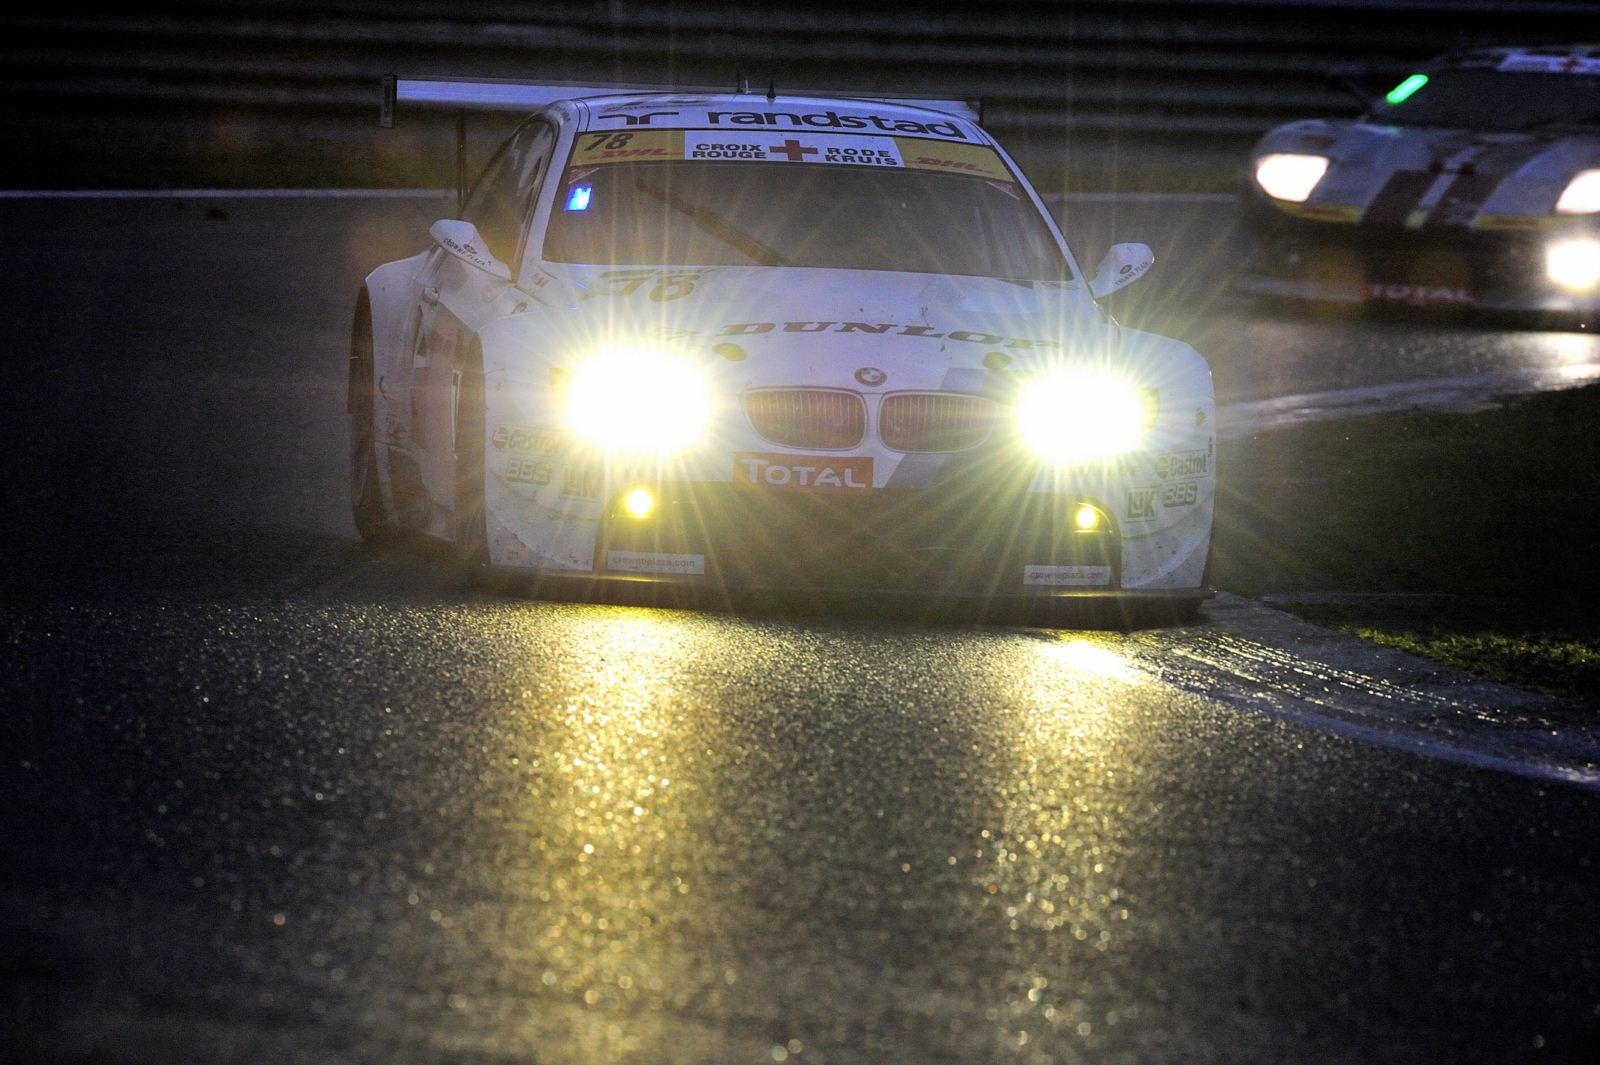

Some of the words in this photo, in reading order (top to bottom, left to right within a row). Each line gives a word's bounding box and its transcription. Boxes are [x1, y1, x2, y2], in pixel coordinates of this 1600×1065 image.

[706, 109, 967, 139] randstad
[582, 133, 634, 152] 78
[696, 143, 762, 152] CROIX
[827, 146, 891, 158] RODE
[692, 150, 767, 159] ROUGE
[824, 154, 899, 165] KRUIS
[602, 269, 702, 302] 78
[715, 321, 1064, 350] DUNLOP
[740, 458, 868, 488] TOTAL
[1169, 454, 1208, 476] Castrol
[1163, 481, 1198, 508] BBS
